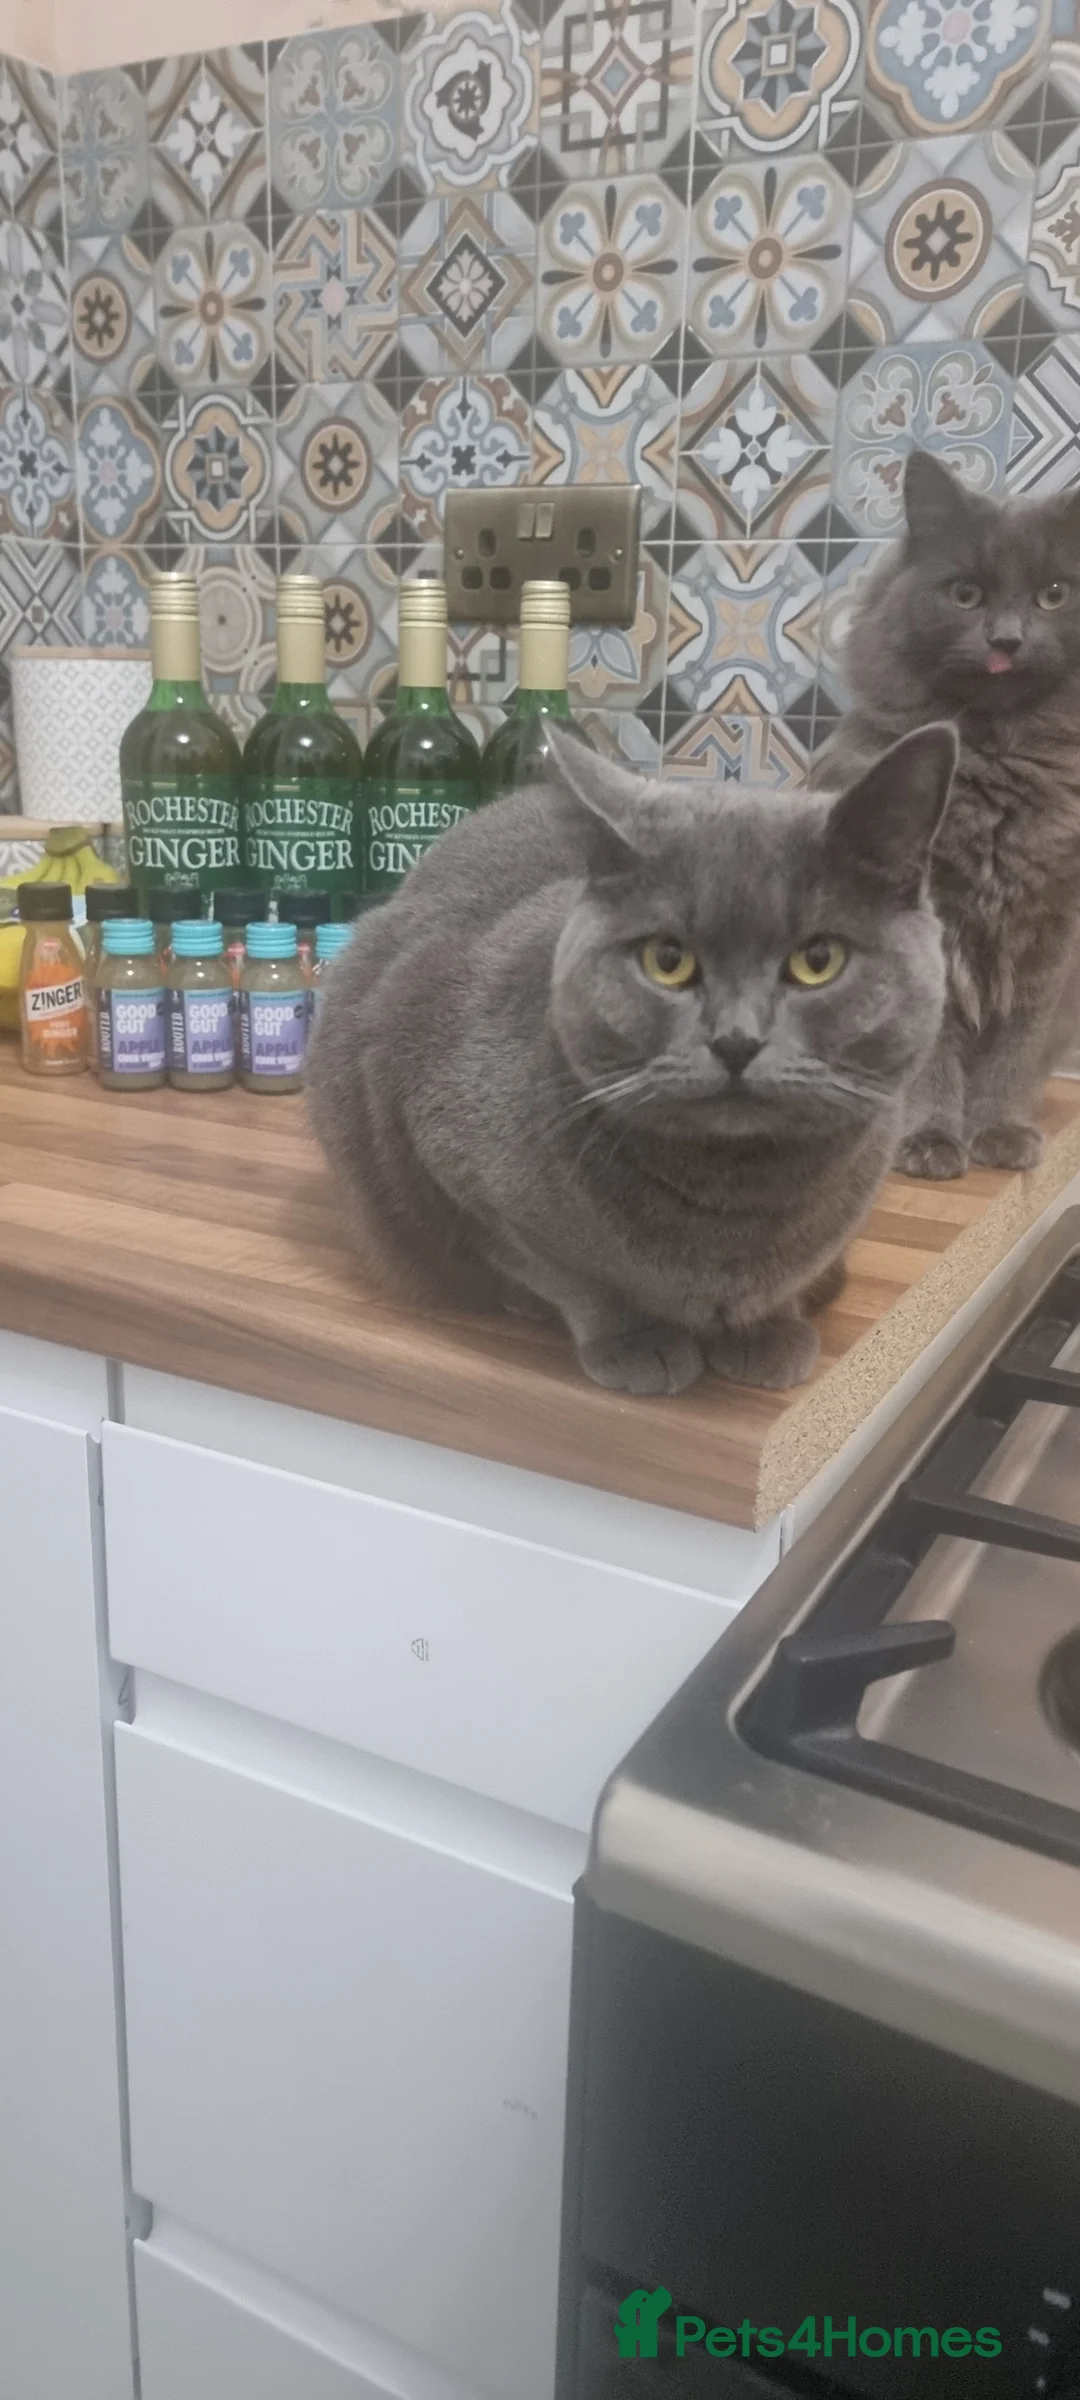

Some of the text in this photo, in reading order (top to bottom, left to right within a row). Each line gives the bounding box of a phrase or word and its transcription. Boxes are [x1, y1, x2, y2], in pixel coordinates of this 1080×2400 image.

[126, 796, 239, 831] ROCHESTER
[368, 803, 469, 836] ROCHEST
[129, 836, 240, 869] GINGER
[246, 838, 354, 871] GINGER
[116, 1004, 156, 1019] GOOD
[190, 1003, 228, 1019] GOOD
[254, 1007, 294, 1021] GOOD
[116, 1020, 146, 1034] GUT
[190, 1019, 218, 1033] GUT
[255, 1021, 282, 1036] GUT
